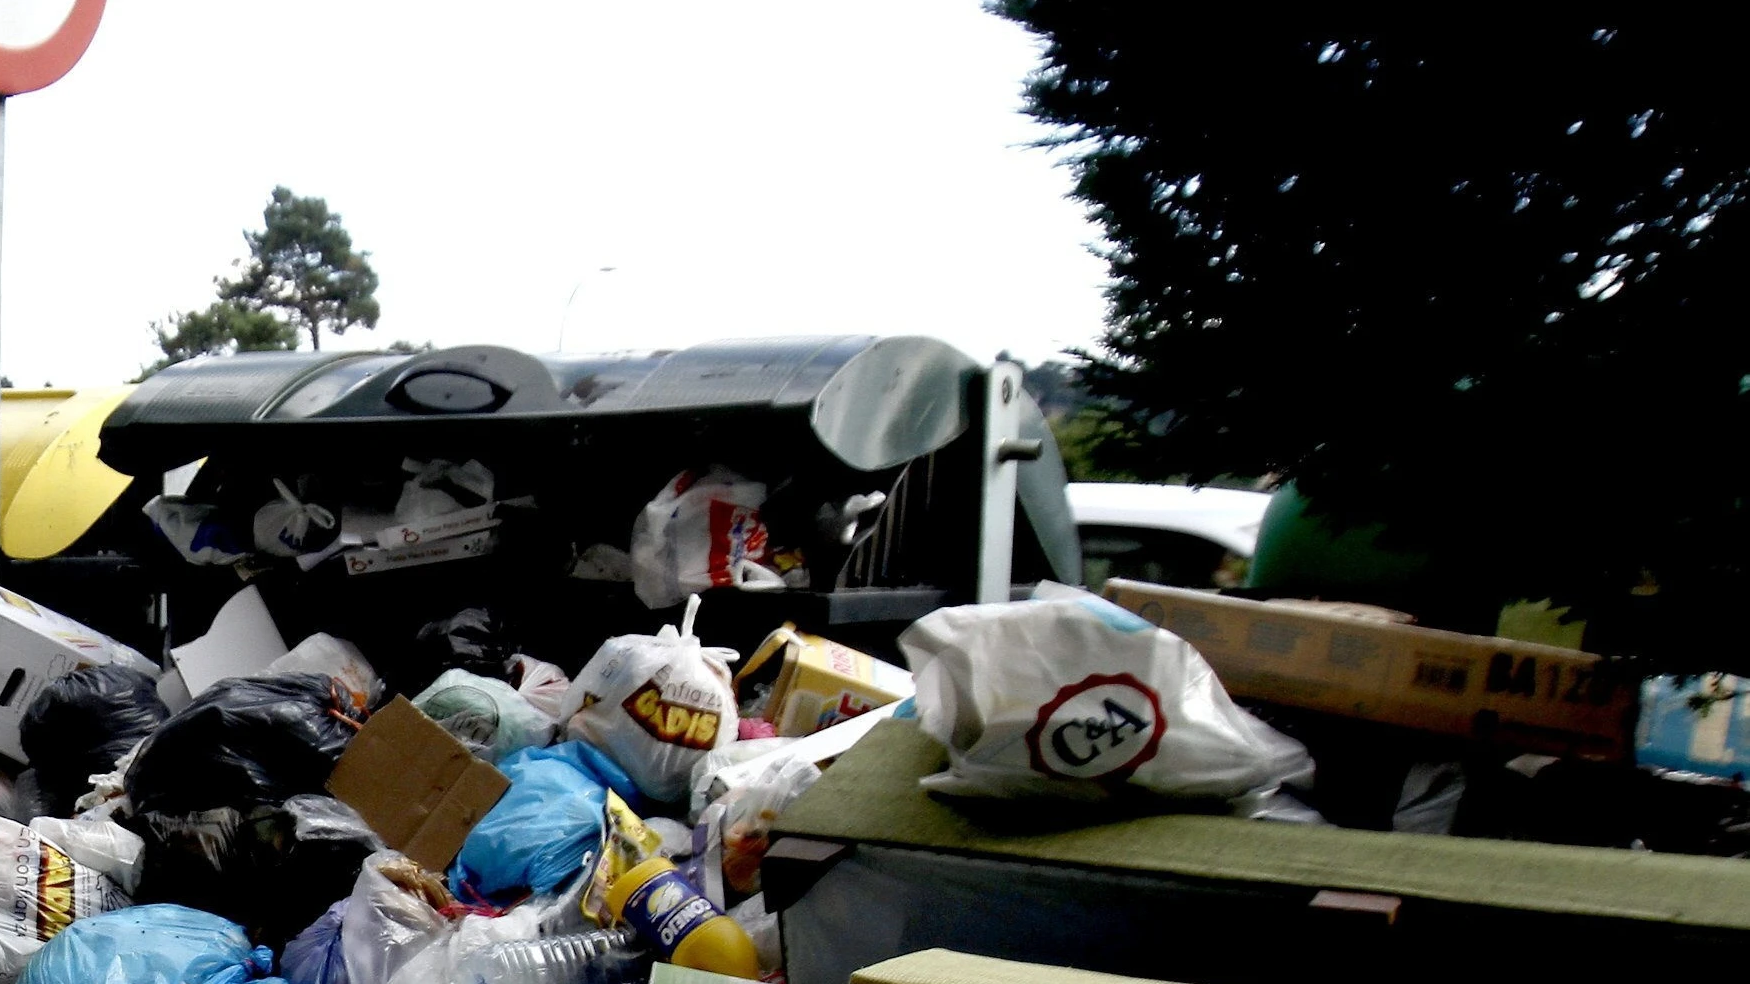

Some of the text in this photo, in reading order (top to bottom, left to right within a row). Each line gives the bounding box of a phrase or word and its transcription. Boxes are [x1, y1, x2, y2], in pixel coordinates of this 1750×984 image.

[635, 688, 719, 743] GADIS
[1052, 698, 1152, 767] C&A
[660, 897, 713, 946] CONEJO
